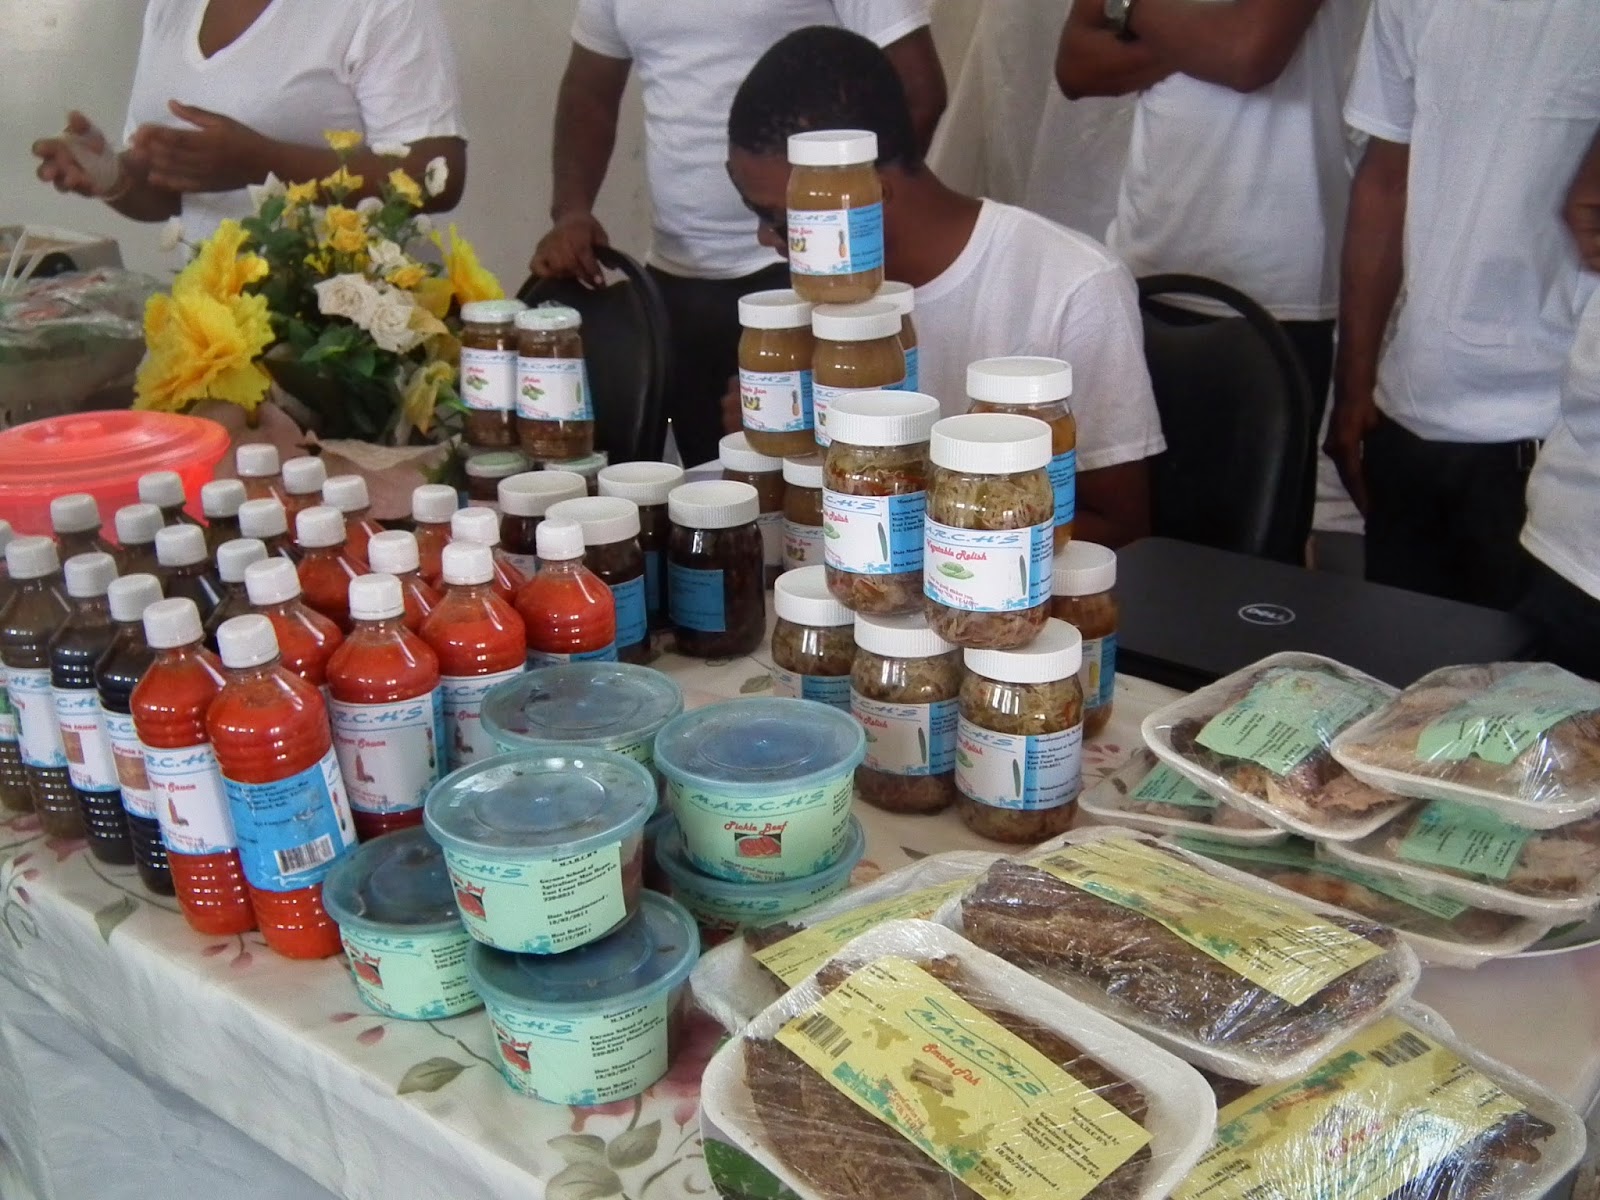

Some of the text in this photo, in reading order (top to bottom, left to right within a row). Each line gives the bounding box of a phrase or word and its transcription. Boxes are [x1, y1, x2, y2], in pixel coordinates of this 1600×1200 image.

[927, 538, 987, 562] Vegetable Relish
[692, 790, 825, 812] M.A.R.C.H'S
[724, 820, 789, 836] Pickle Beef
[911, 1009, 1043, 1096] M.A.R.C.H'S
[922, 1043, 982, 1087] Smoke Fish
